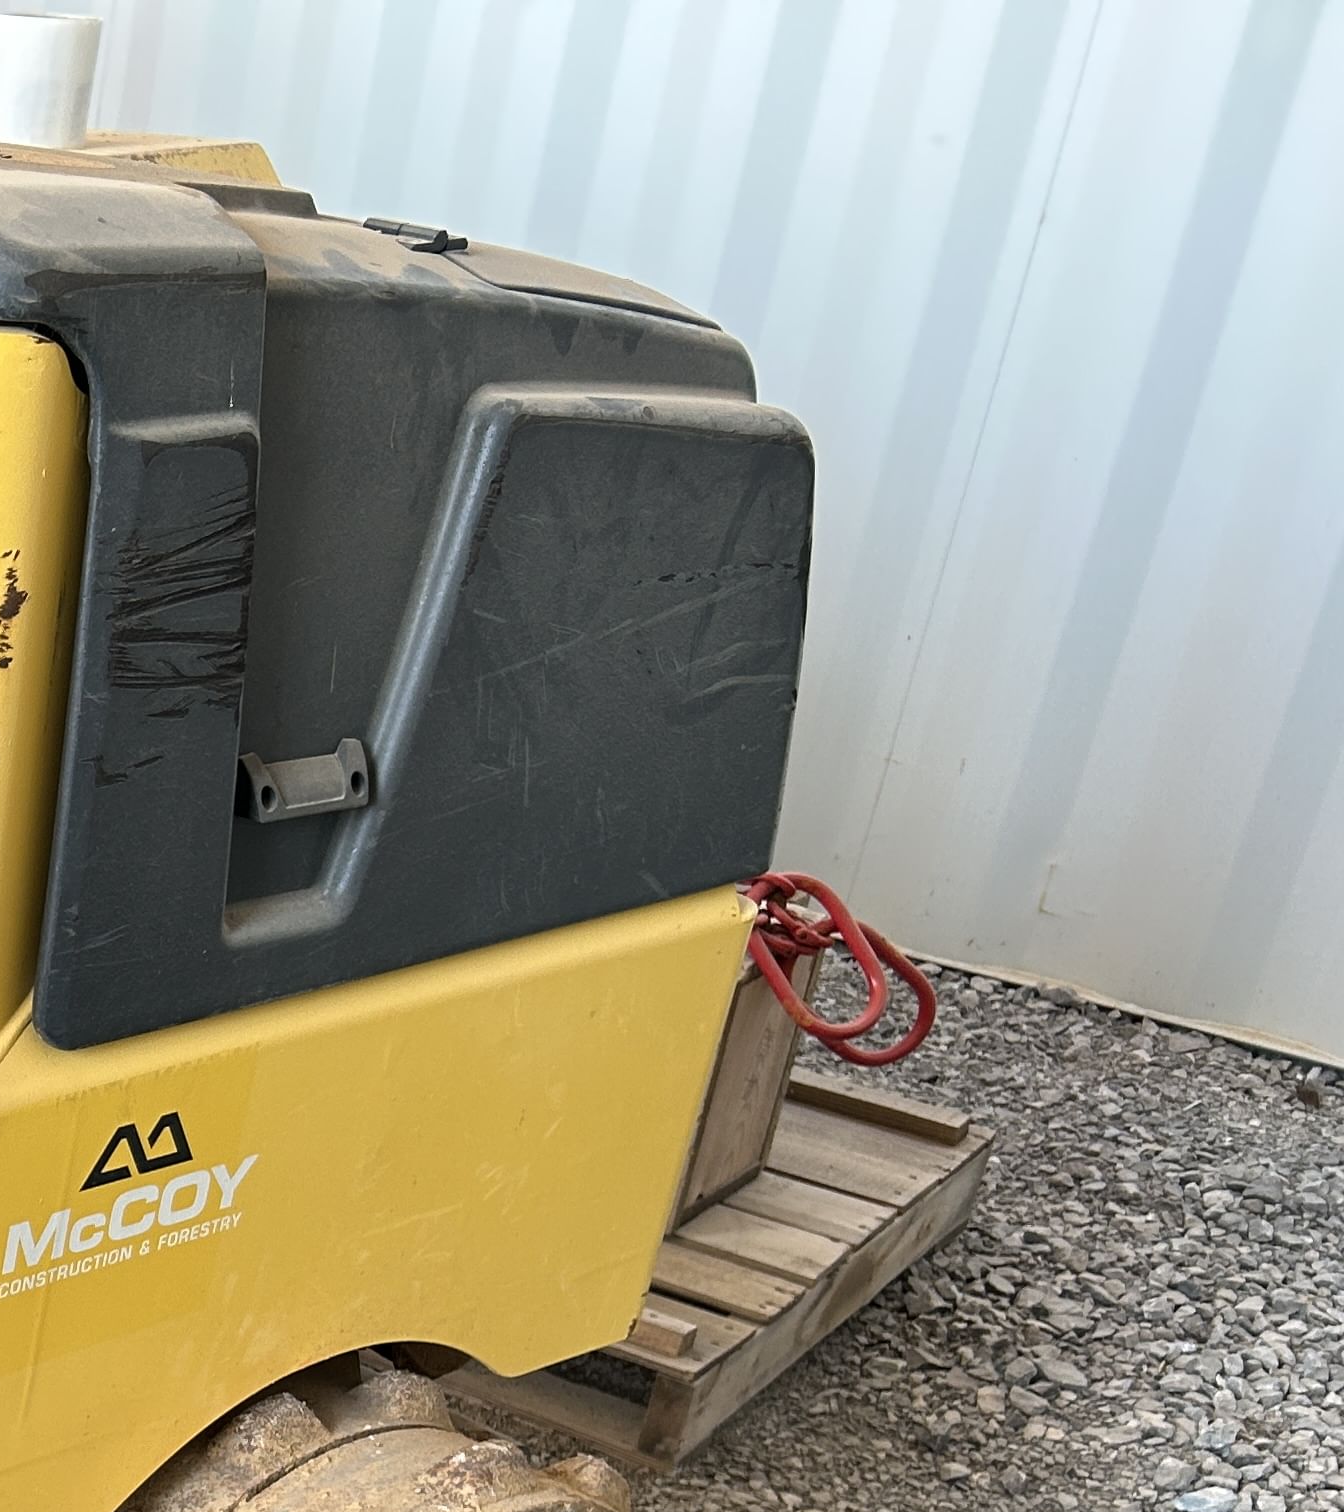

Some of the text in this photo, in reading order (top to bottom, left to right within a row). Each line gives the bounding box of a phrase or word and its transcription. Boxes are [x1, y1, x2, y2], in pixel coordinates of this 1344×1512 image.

[2, 1154, 259, 1275] McCOY
[139, 1241, 150, 1256] &
[157, 1212, 242, 1251] FORESTRY
